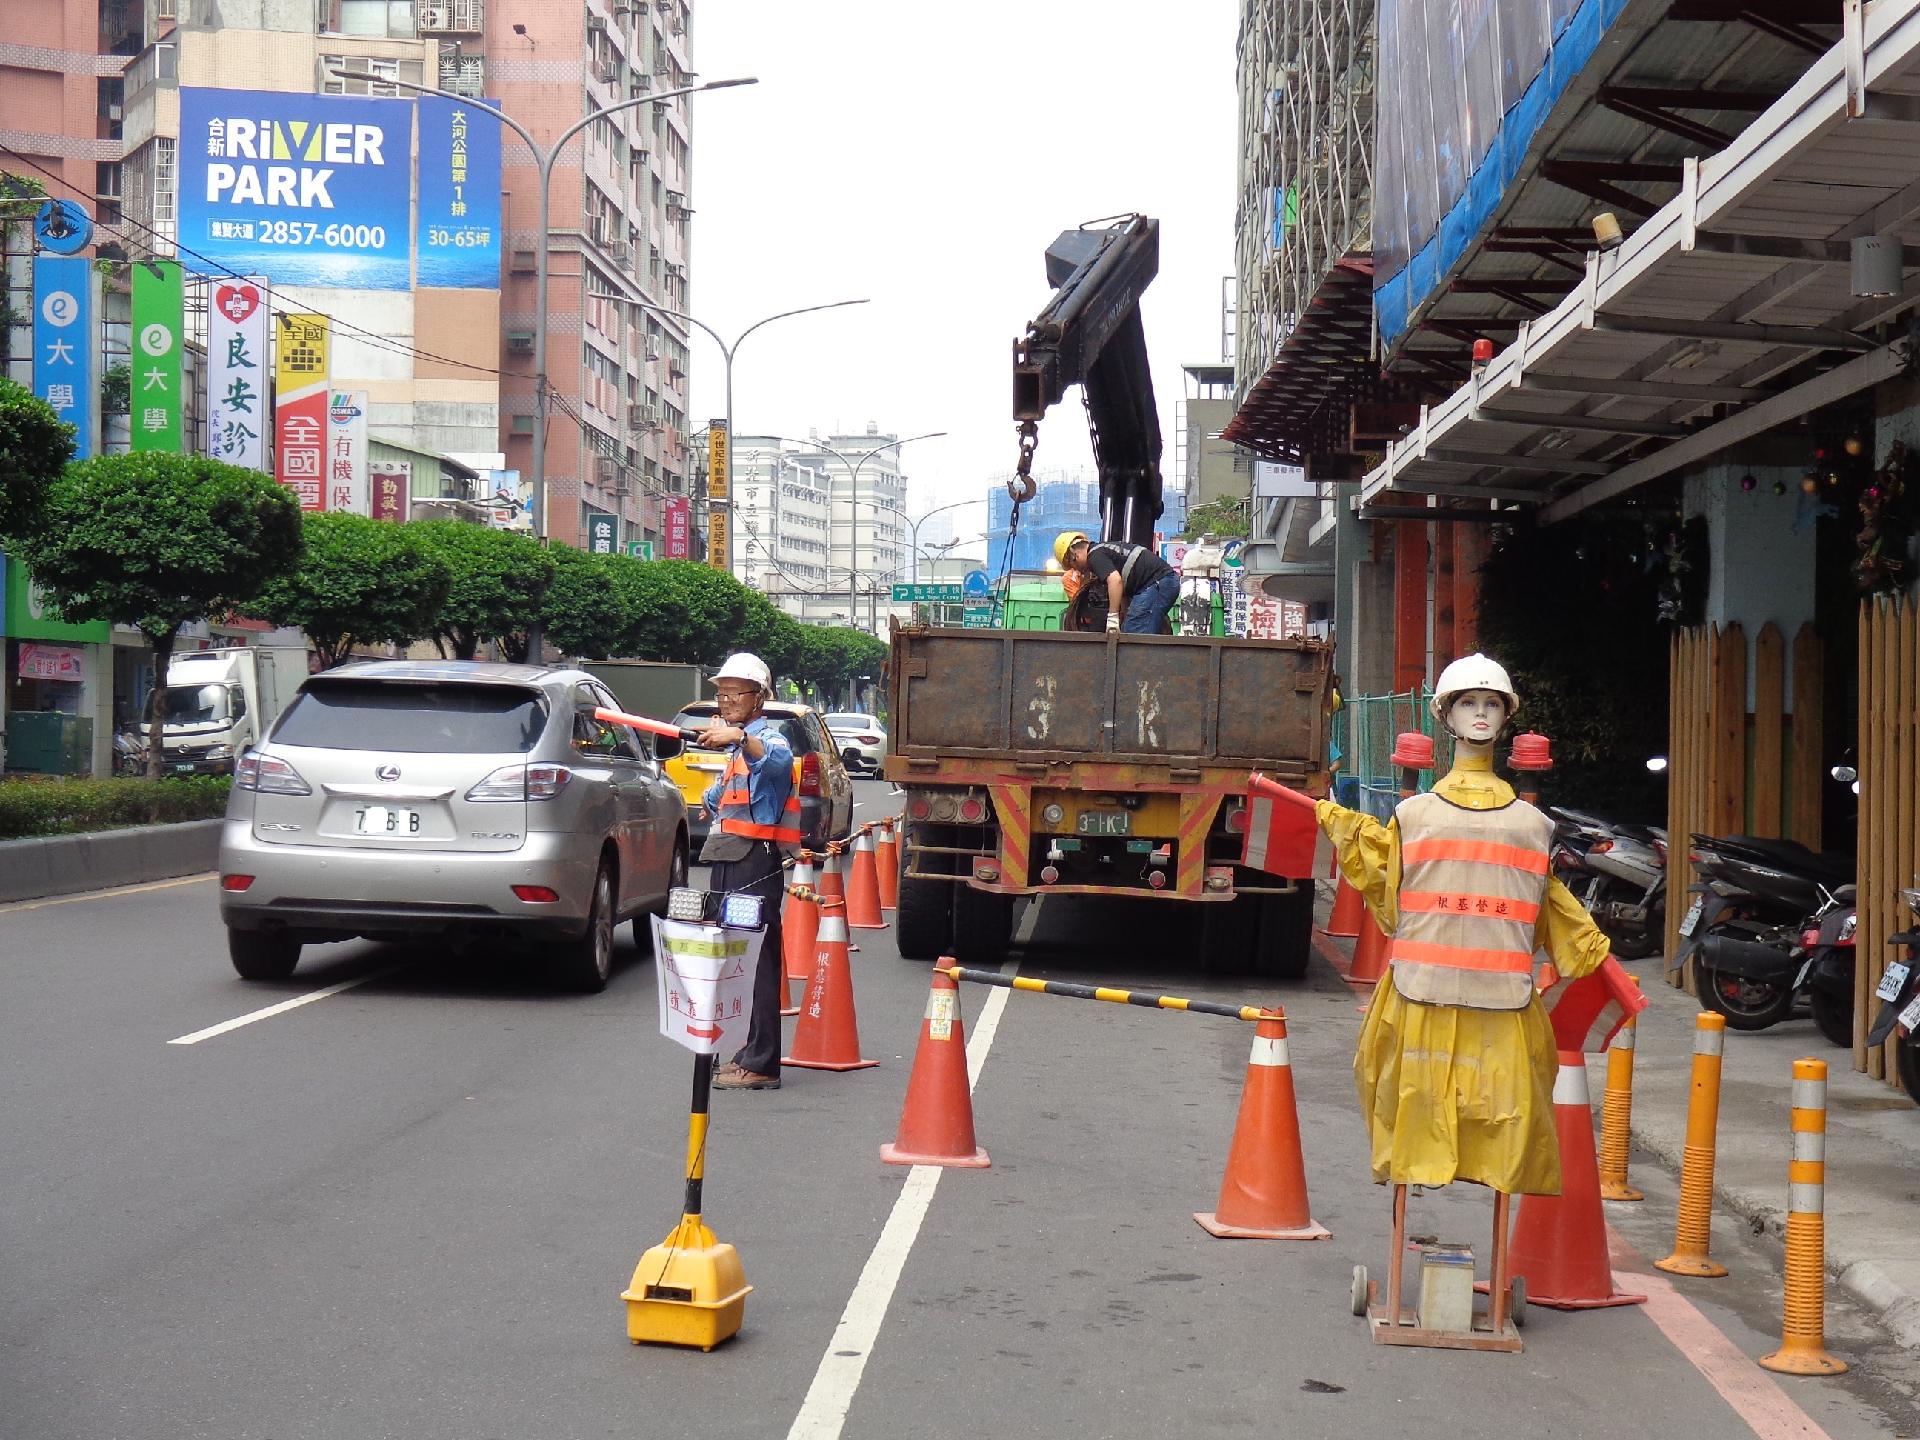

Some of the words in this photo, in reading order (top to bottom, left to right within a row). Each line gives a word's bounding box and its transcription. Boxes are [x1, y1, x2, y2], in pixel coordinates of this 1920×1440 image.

[207, 117, 225, 157] 合新
[450, 109, 467, 217] 大河公園第1排
[206, 162, 336, 209] PARK
[257, 219, 387, 249] 2857-6000
[427, 229, 491, 248] 30-65坪
[221, 331, 258, 460] 良安診
[332, 435, 353, 512] 有機保
[1437, 896, 1509, 915] 根基營造
